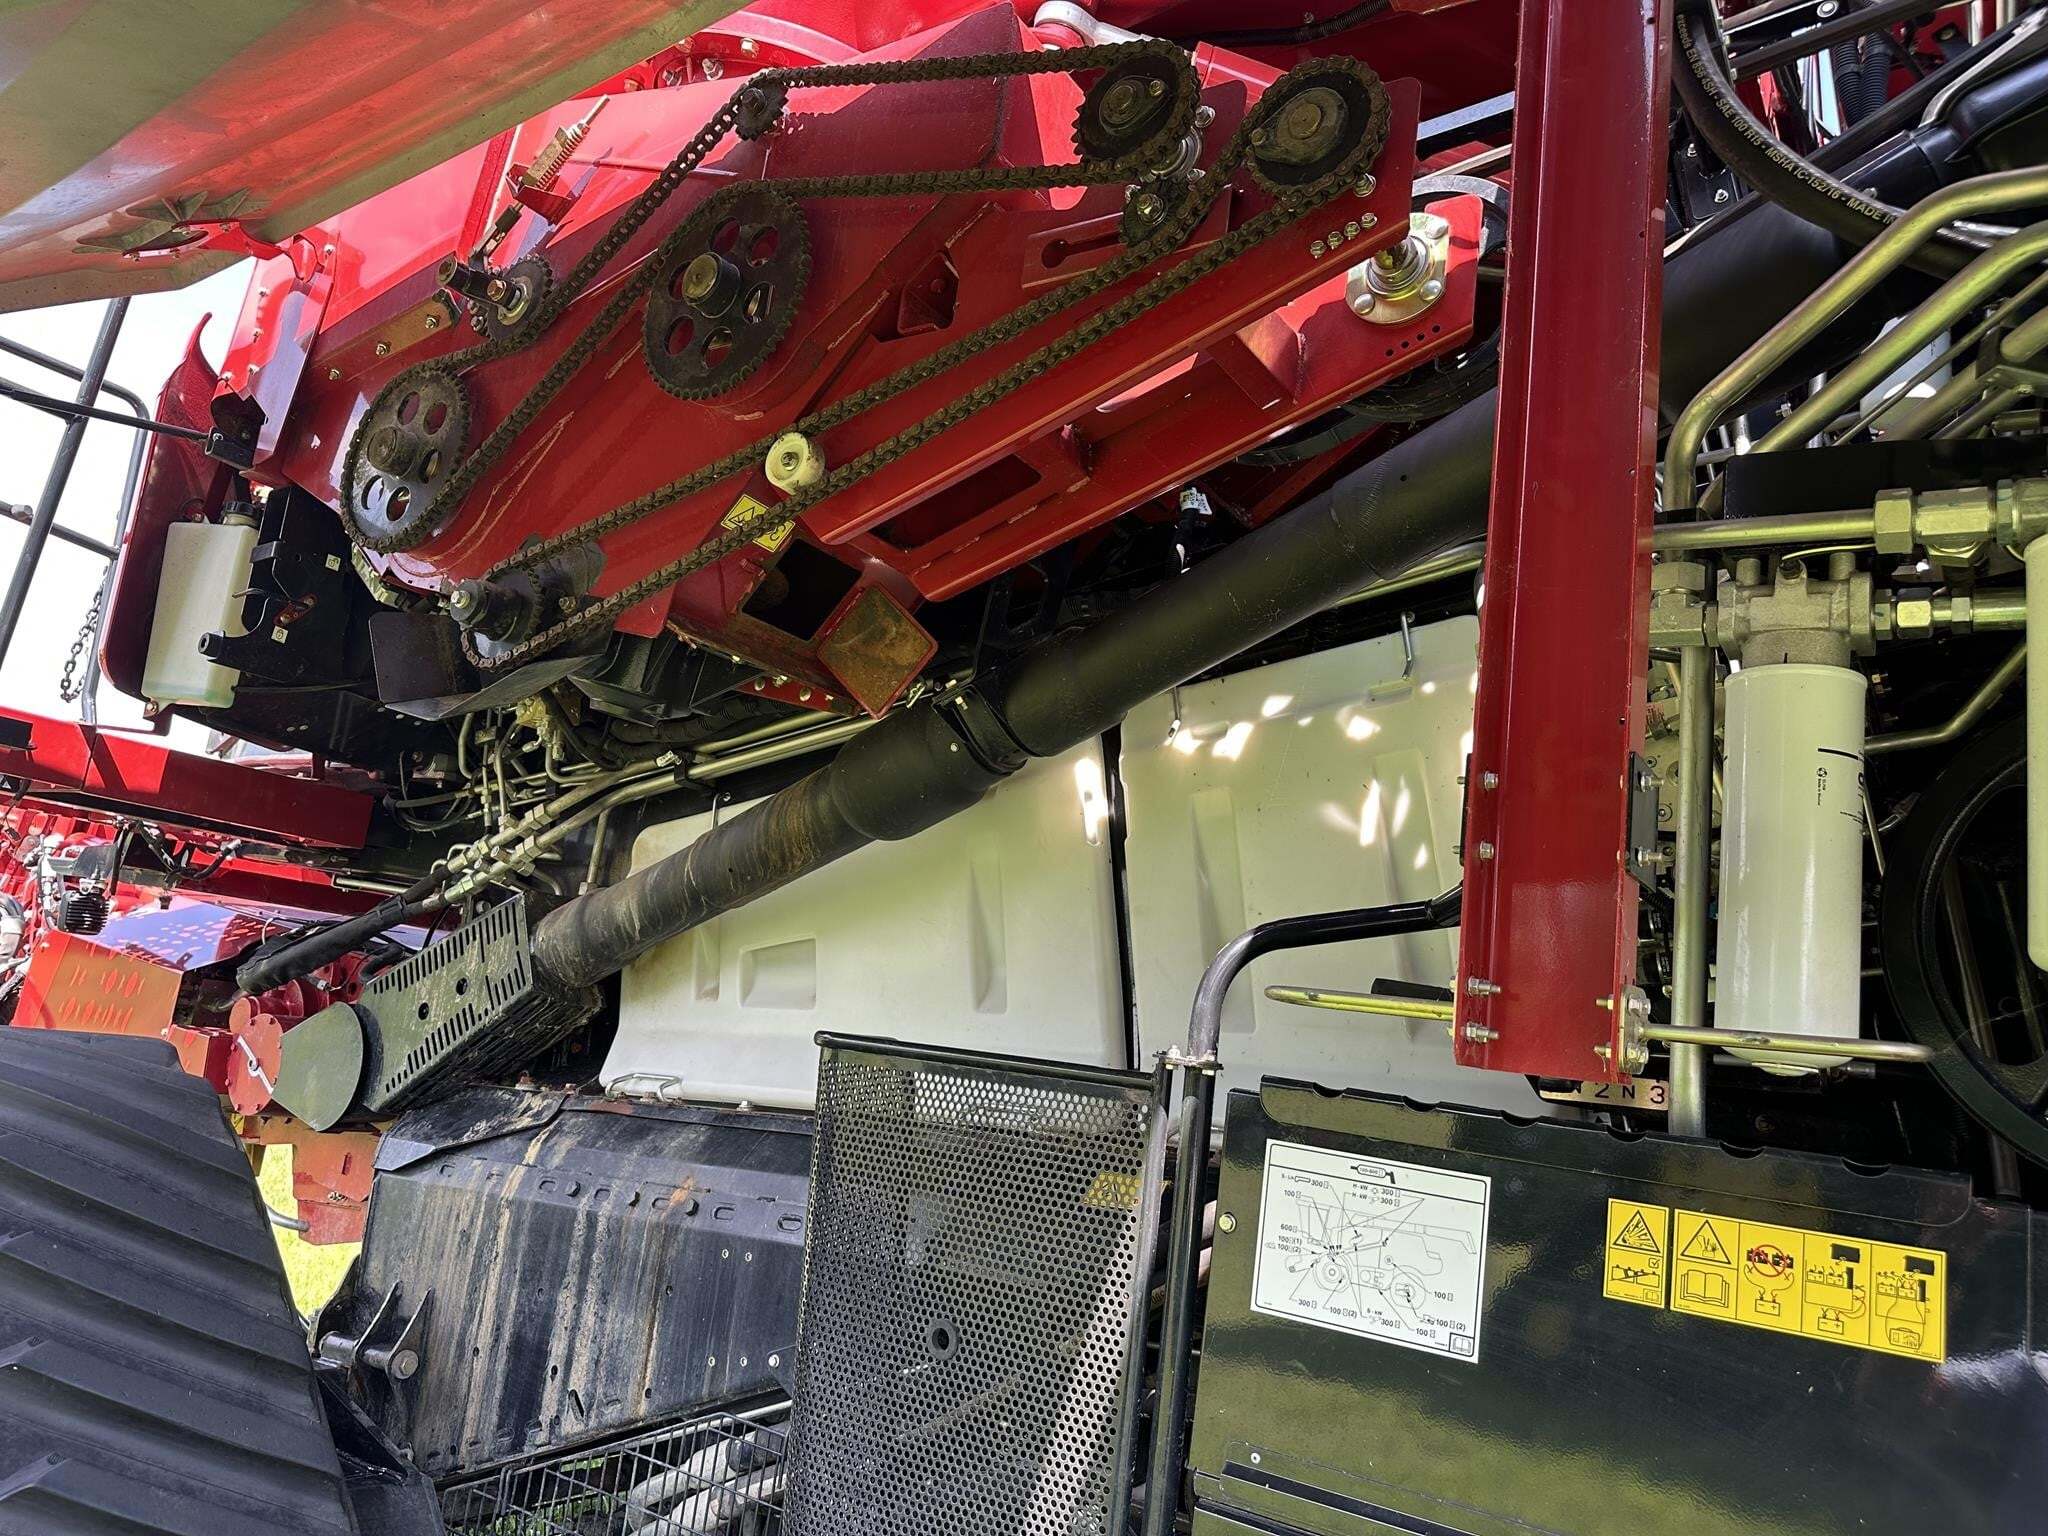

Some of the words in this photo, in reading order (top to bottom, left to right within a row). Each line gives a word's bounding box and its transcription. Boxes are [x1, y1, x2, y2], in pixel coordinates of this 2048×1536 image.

[1686, 47, 1698, 63] EN
[1691, 60, 1706, 78] 856
[1701, 75, 1719, 97] 4SH
[1715, 98, 1735, 118] SAE
[1730, 115, 1750, 133] 100
[1743, 126, 1762, 146] R15
[1765, 146, 1794, 173] MSHA
[1792, 167, 1841, 201] IC-152/16
[1846, 197, 1884, 221] MADE
[1594, 1083, 1610, 1098] 2
[1622, 1083, 1636, 1099] N
[1649, 1085, 1666, 1105] 3
[1311, 1179, 1324, 1188] 300
[1284, 1189, 1295, 1198] 100
[1381, 1188, 1394, 1196] 300
[1380, 1197, 1393, 1206] 300
[1280, 1223, 1293, 1232] 600
[1278, 1235, 1289, 1244] 100
[1277, 1243, 1289, 1251] 100
[1434, 1291, 1447, 1300] 100
[1298, 1298, 1311, 1308] 300
[1329, 1306, 1342, 1316] 100
[1348, 1310, 1358, 1319] (2)
[1380, 1318, 1394, 1327] 300
[1436, 1318, 1449, 1328] 100
[1456, 1322, 1466, 1332] (2)
[1416, 1327, 1429, 1337] 100
